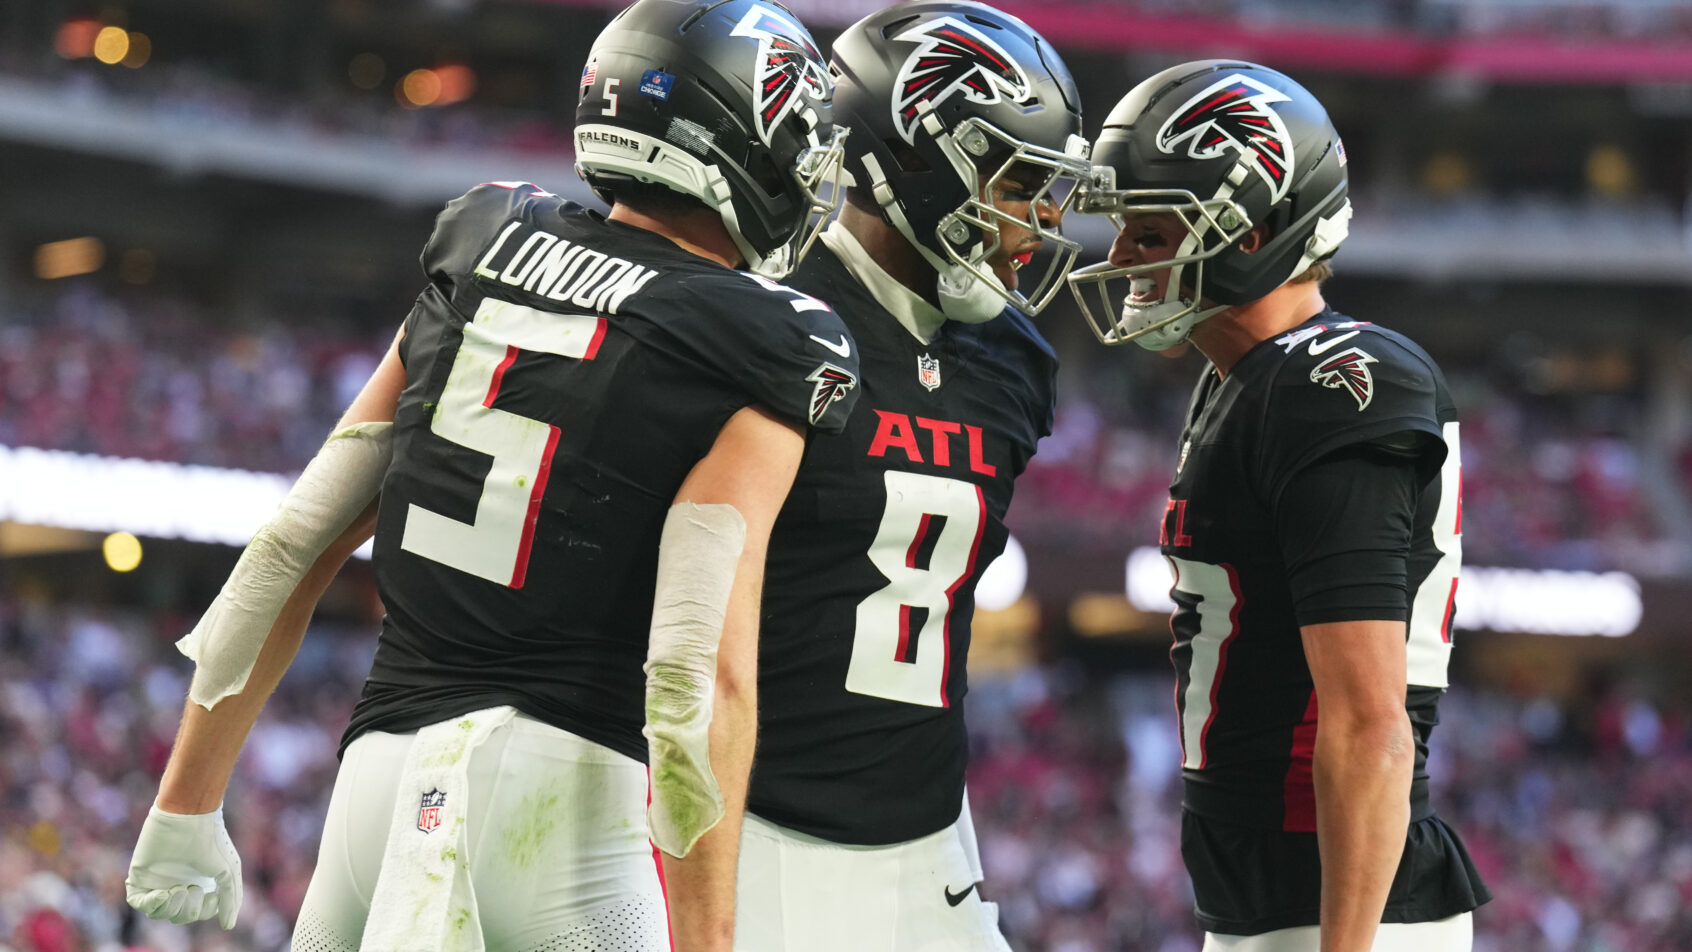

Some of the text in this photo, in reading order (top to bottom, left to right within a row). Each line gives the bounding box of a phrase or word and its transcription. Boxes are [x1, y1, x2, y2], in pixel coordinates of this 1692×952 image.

[602, 77, 621, 116] 5
[579, 131, 640, 150] FALCONS
[474, 221, 659, 315] LONDON
[922, 369, 937, 385] NFL
[401, 297, 608, 589] 5
[867, 409, 997, 478] ATL
[845, 470, 988, 708] 8
[419, 807, 441, 830] NFL
